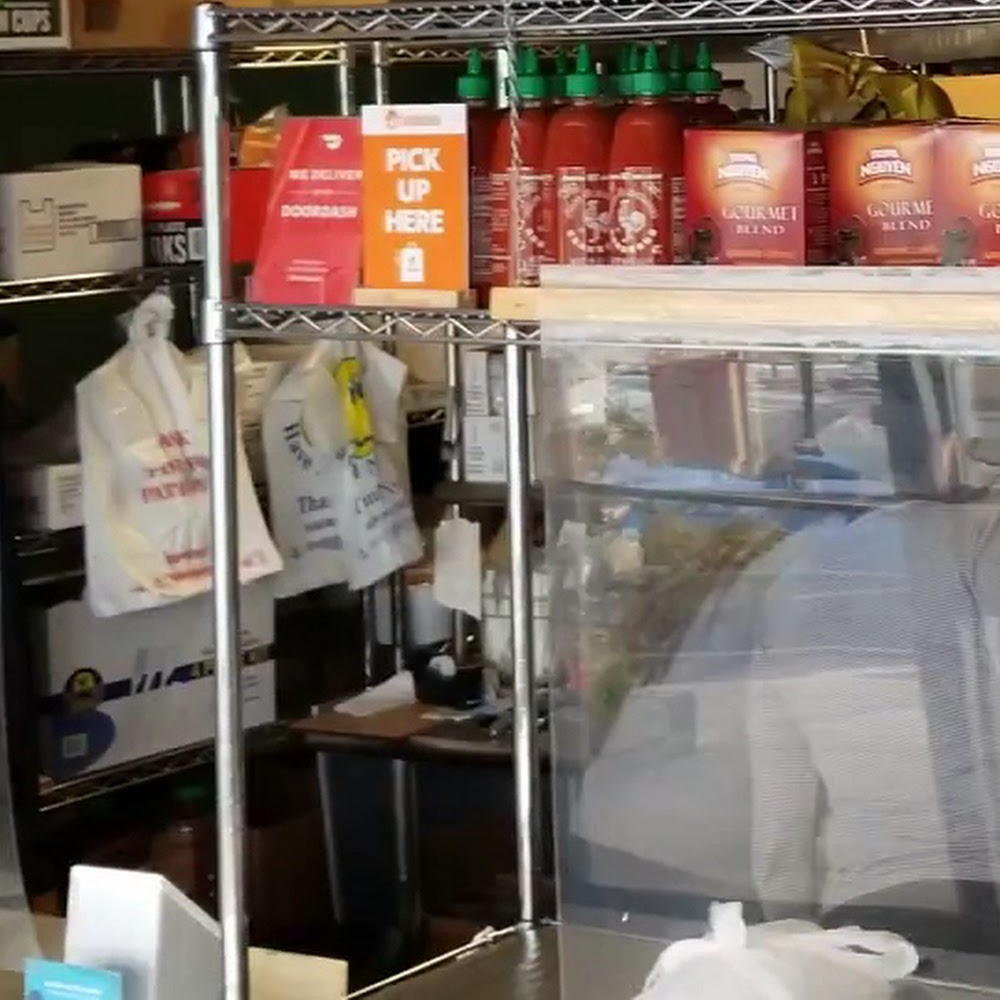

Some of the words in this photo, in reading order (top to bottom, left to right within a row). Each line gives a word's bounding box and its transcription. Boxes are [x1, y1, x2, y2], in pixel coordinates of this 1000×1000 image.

[385, 147, 444, 172] PICK
[397, 178, 431, 203] UP
[384, 209, 445, 233] HERE
[722, 204, 799, 222] GOURMET
[736, 224, 785, 234] BLEND
[882, 221, 931, 231] BLEND
